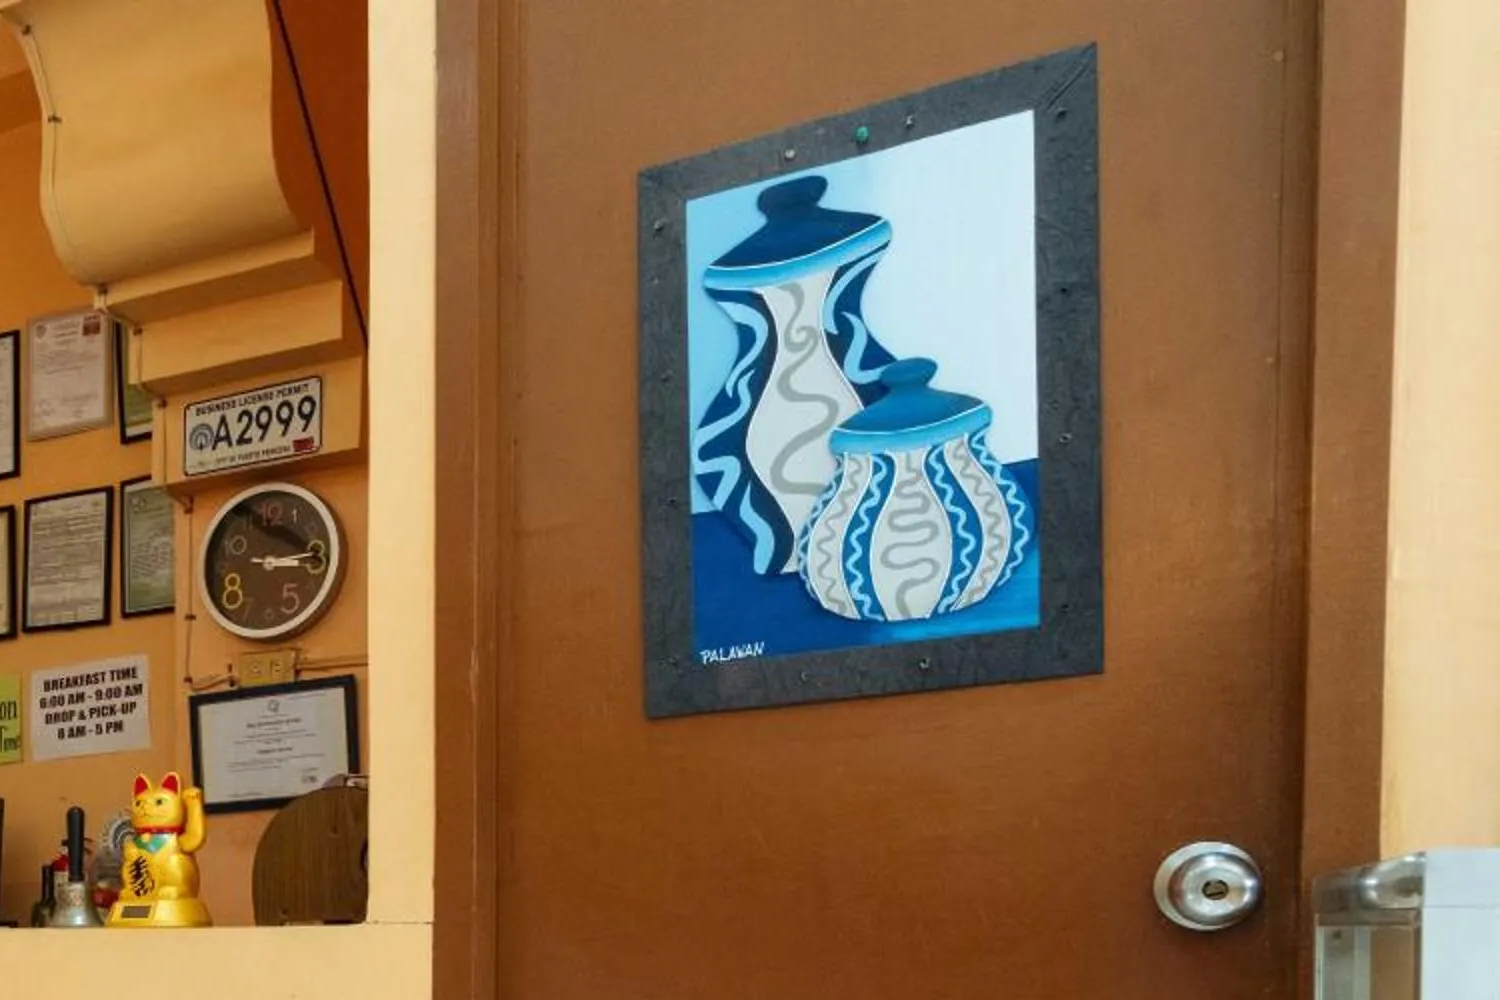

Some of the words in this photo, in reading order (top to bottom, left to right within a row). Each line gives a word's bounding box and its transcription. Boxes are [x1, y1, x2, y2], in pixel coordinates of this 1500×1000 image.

[212, 396, 317, 451] A2999
[700, 641, 765, 664] PALAWAN
[43, 671, 106, 692] BREAKFAST
[109, 666, 137, 681] TIME
[67, 691, 85, 705] AM
[124, 683, 143, 698] AM
[45, 709, 76, 725] DROP
[78, 710, 86, 721] &
[89, 701, 136, 719] PICK-UP
[67, 726, 86, 738] AM
[105, 720, 123, 734] PM
